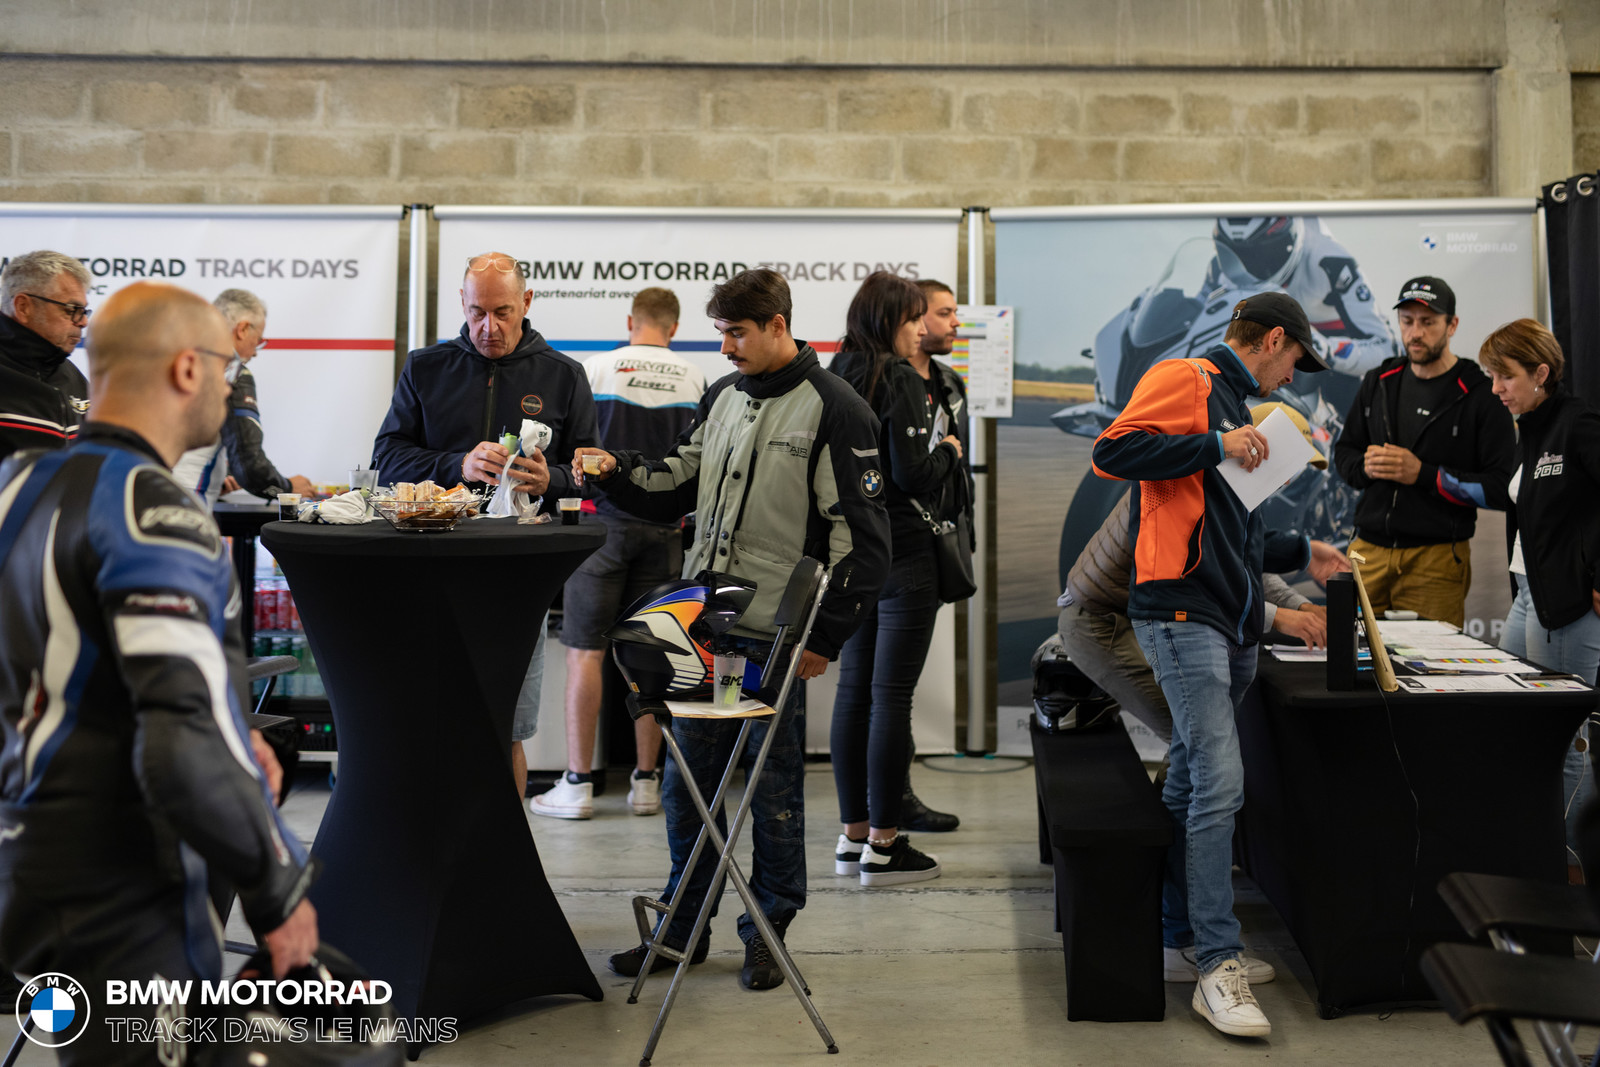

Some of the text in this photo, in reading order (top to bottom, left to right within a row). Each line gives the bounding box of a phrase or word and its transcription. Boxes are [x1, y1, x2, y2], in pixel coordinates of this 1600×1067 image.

[1446, 232, 1478, 242] BMW
[1446, 243, 1518, 253] MOTORRAD
[77, 258, 359, 279] ORRAD TRACK DAYS
[519, 261, 583, 280] BMW
[593, 261, 748, 281] MOTORRAD
[533, 287, 606, 300] partenariat
[614, 359, 688, 376] DRAGON
